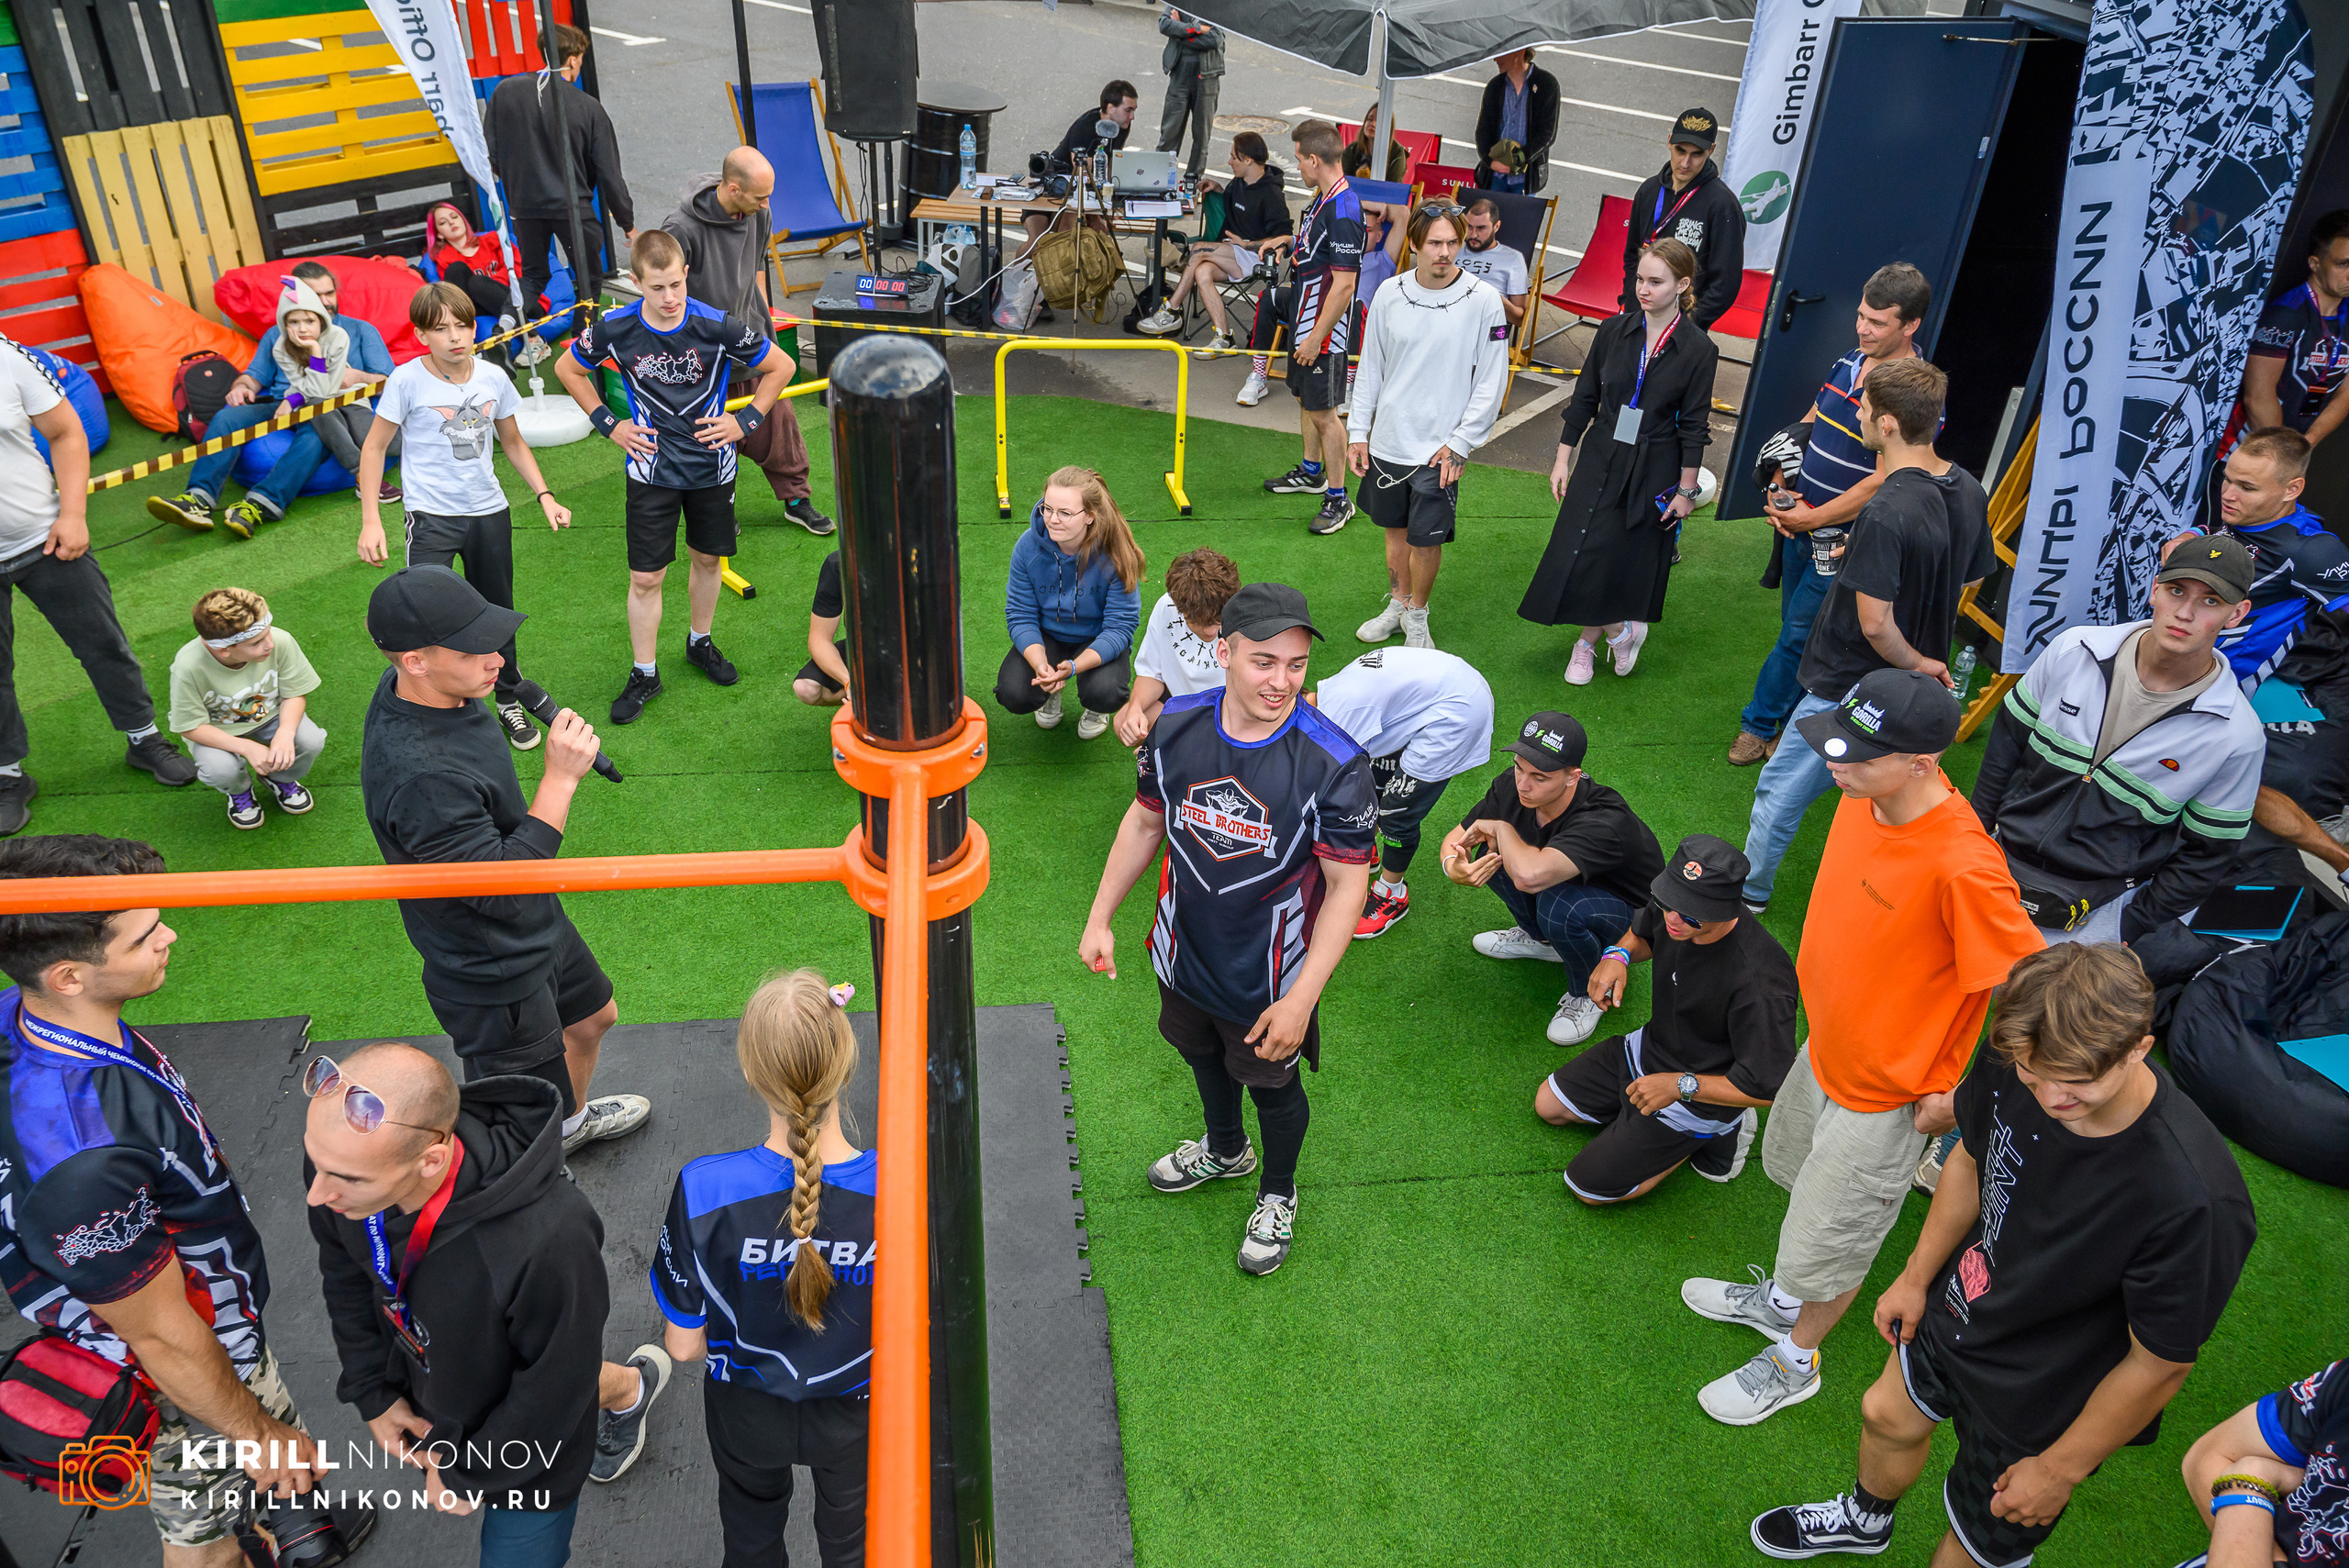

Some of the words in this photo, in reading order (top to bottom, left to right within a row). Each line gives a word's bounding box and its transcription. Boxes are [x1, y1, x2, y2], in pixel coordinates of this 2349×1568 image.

[1772, 18, 1820, 145] Gimbarr
[1442, 178, 1476, 189] SUNLI
[1676, 217, 1704, 235] BRING
[859, 278, 874, 289] 00
[874, 279, 889, 291] 00
[891, 281, 906, 293] 00
[2316, 561, 2349, 580] Ули
[1038, 584, 1067, 596] ORN
[1851, 706, 1882, 732] GORILLA
[1542, 734, 1564, 751] GORILLA
[1181, 804, 1211, 826] STEEL
[1215, 813, 1272, 841] BROTHERS
[1211, 831, 1232, 846] TEAM
